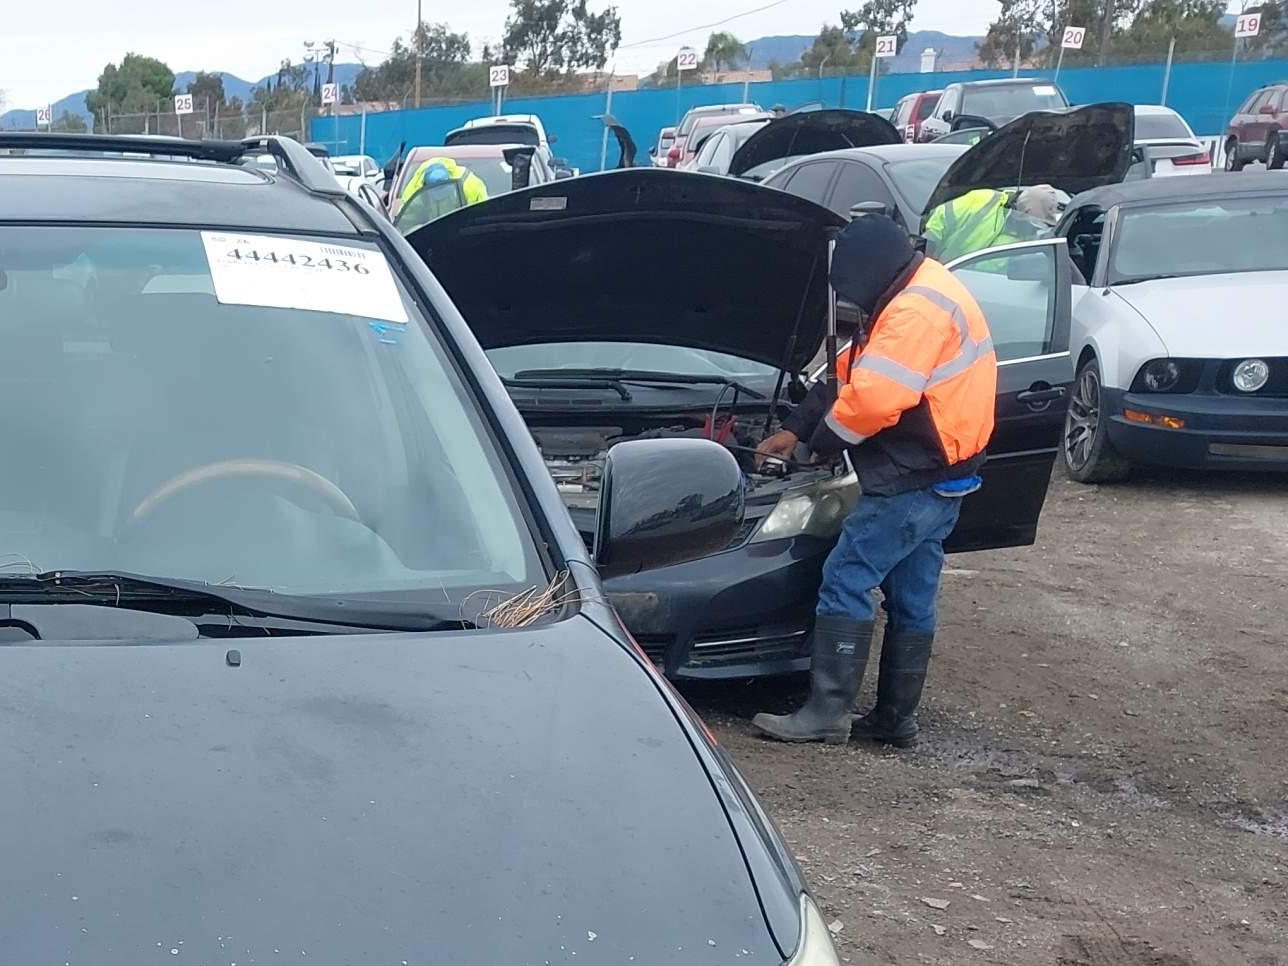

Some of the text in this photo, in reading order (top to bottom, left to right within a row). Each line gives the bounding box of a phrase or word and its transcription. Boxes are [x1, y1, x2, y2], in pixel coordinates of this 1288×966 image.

[1237, 19, 1257, 32] 19
[1064, 31, 1082, 44] 20
[877, 41, 894, 53] 21
[679, 53, 696, 66] 22
[491, 71, 507, 83] 23
[177, 98, 191, 111] 25
[226, 248, 370, 275] 44442436
